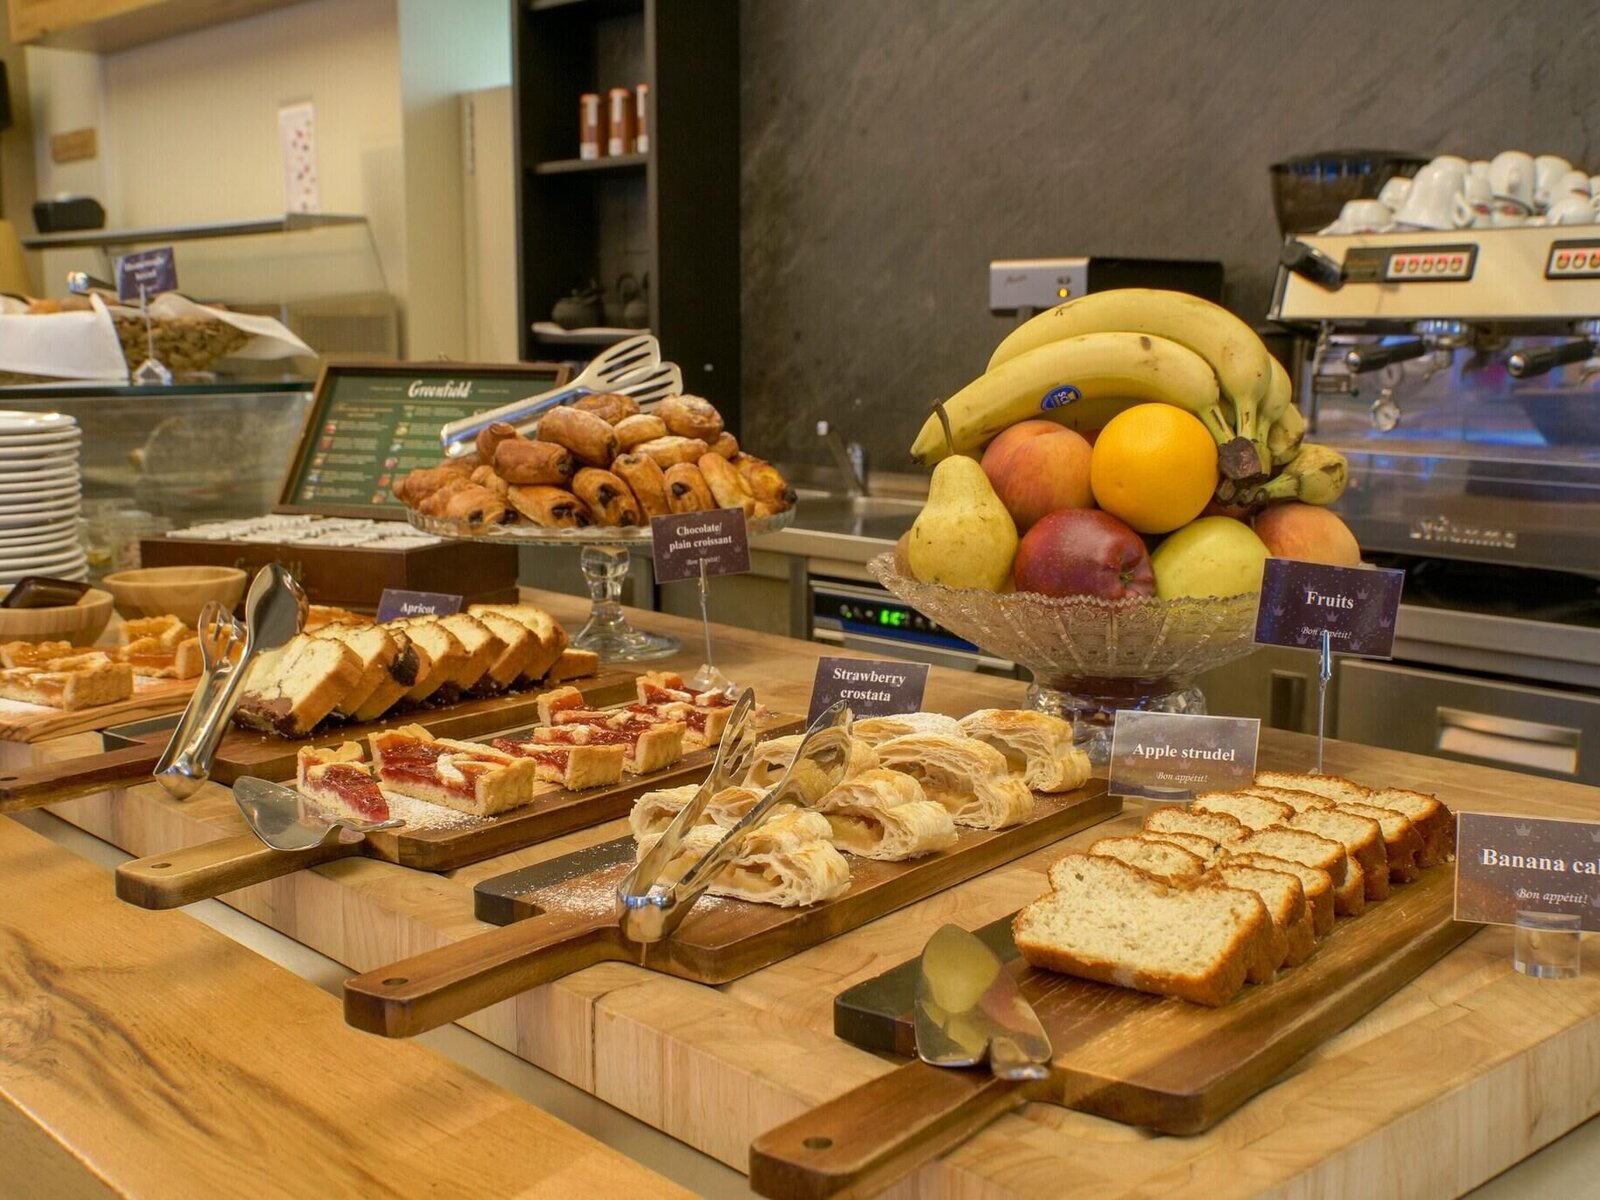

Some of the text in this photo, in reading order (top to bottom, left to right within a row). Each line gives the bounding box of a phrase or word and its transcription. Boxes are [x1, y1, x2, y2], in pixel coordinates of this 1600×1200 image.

[408, 380, 470, 398] Greenfield
[676, 522, 722, 536] Chocolate/
[669, 535, 732, 552] plain croissant
[1305, 591, 1354, 609] Fruits
[400, 602, 435, 615] Apricot
[1301, 626, 1318, 636] Bon
[832, 667, 906, 687] Strawberry
[840, 689, 891, 702] crostata
[1132, 743, 1235, 761] Apple strudel
[1156, 771, 1208, 784] Bon appétit!
[1481, 848, 1600, 875] Banana ca
[1516, 888, 1588, 904] Bon appétit!
